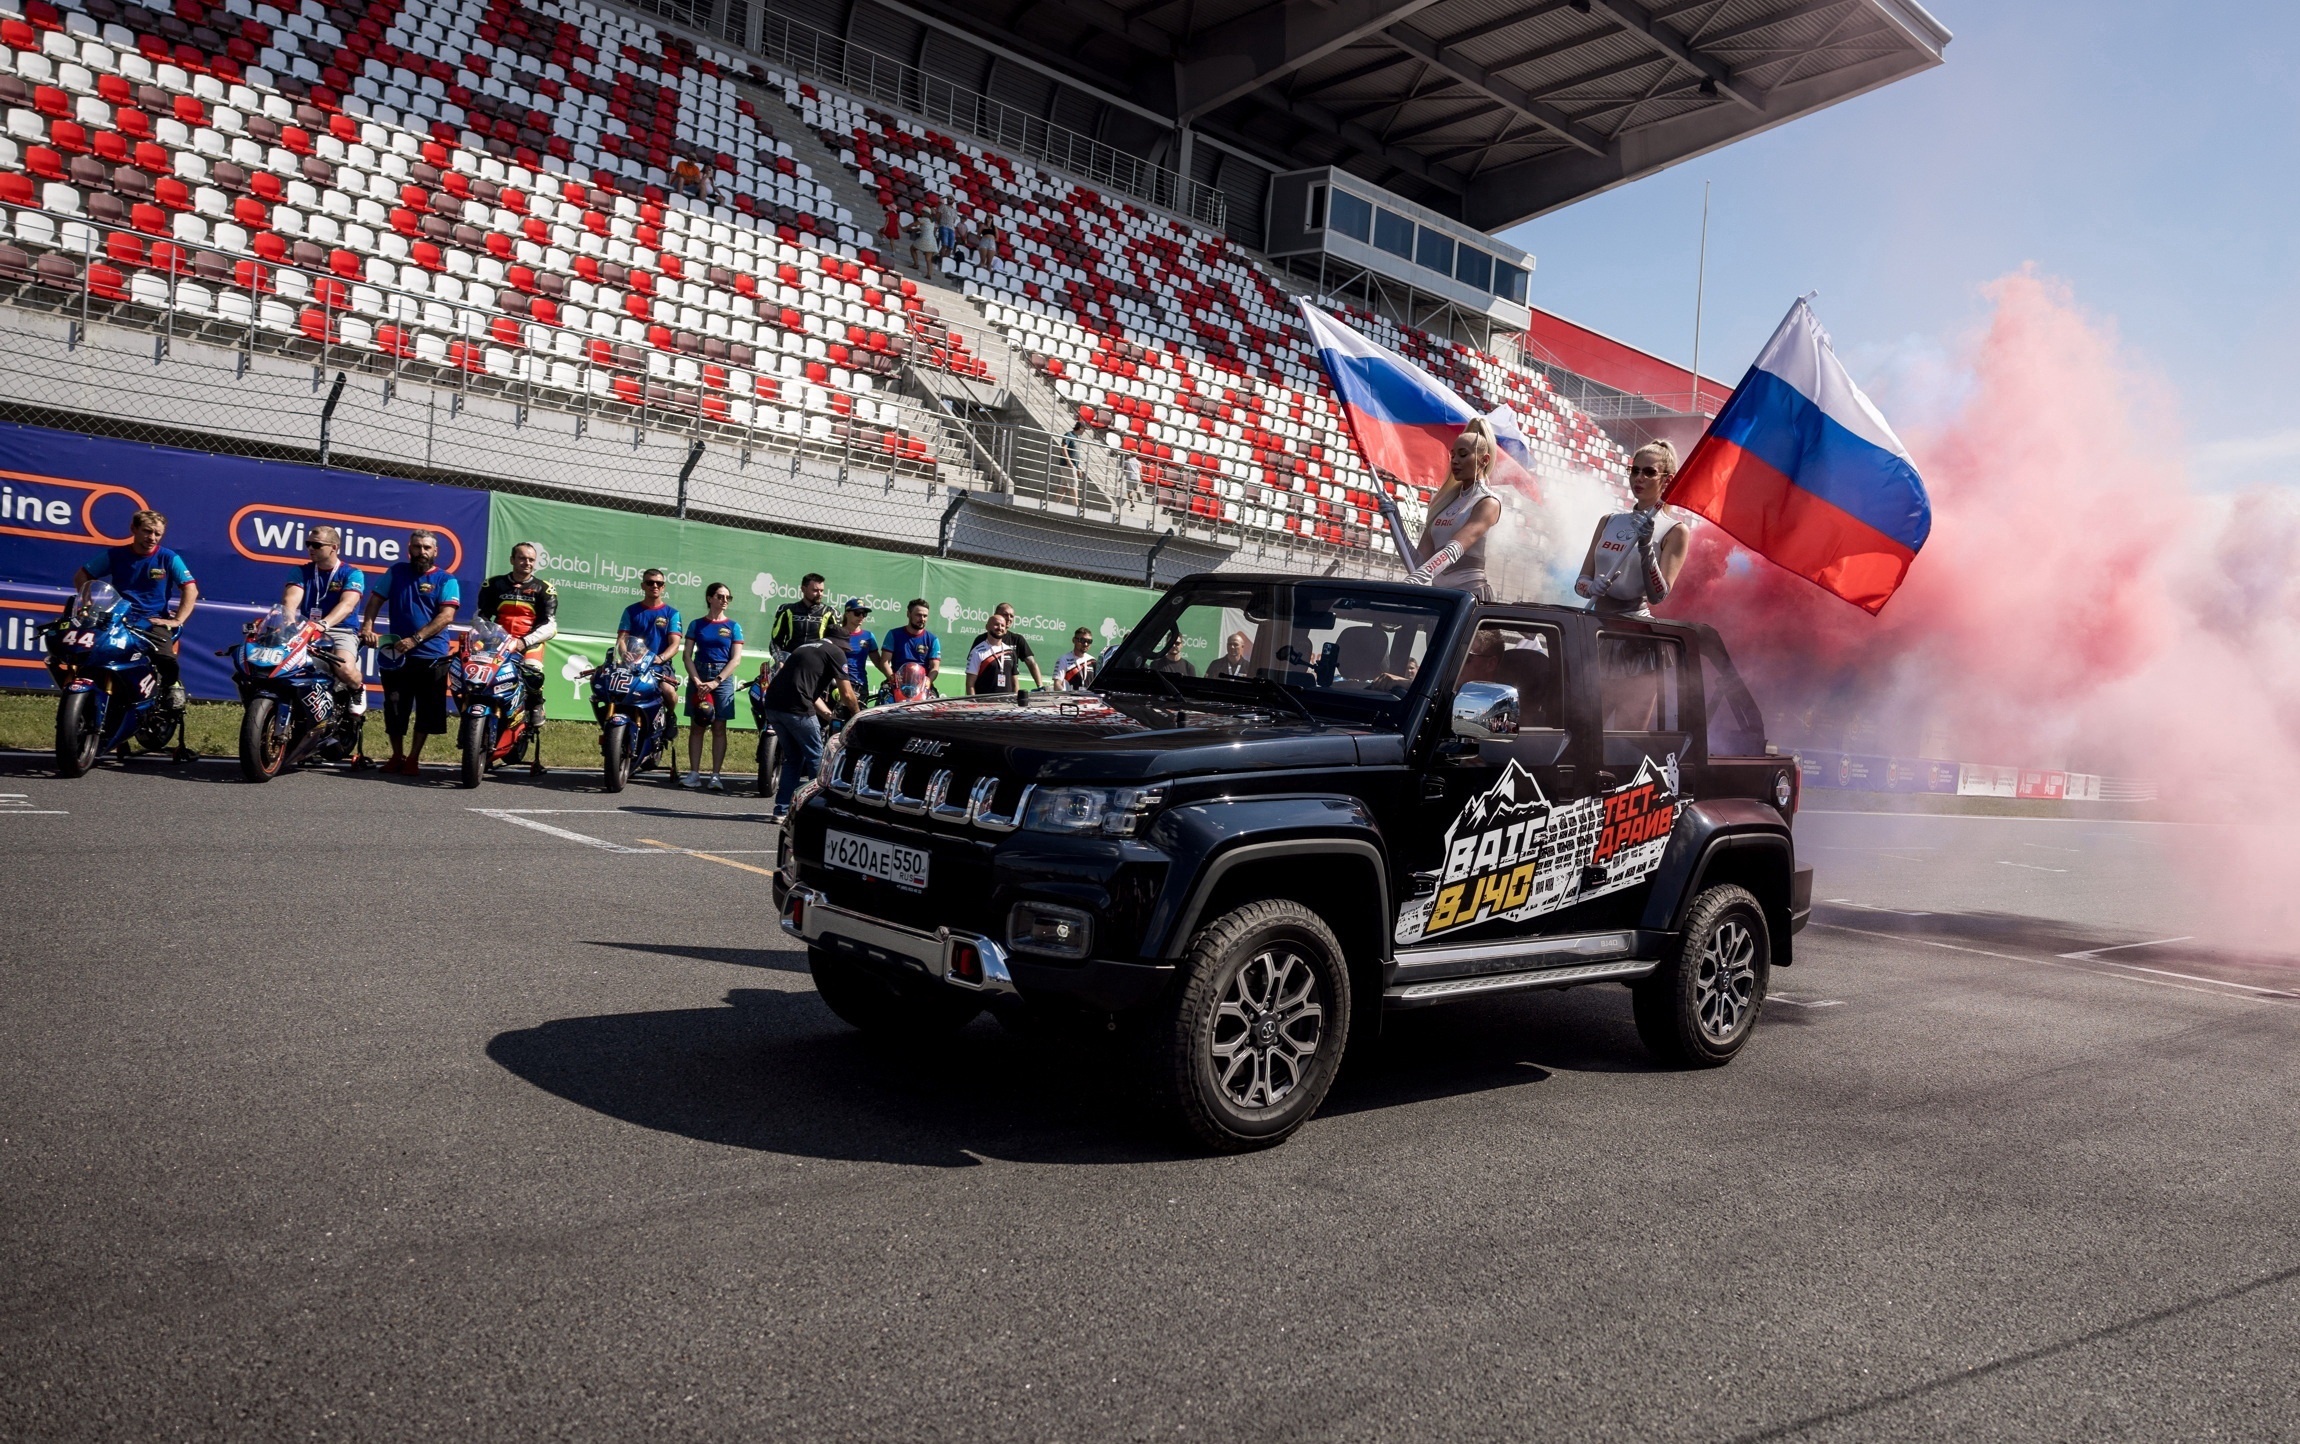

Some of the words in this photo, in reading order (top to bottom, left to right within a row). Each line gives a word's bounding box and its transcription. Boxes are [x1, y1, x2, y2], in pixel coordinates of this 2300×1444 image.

[253, 517, 400, 561] Wiine
[1602, 541, 1627, 552] BAI
[600, 559, 702, 588] HypeScale
[611, 585, 630, 595] ДЛЯ
[62, 629, 95, 648] 44
[246, 647, 285, 666] 246
[465, 663, 492, 683] 91
[609, 671, 633, 693] 12
[139, 673, 157, 698] 44
[302, 682, 334, 723] 246
[902, 737, 951, 758] BAIC
[1604, 784, 1660, 825] ТЕСТ-
[893, 849, 922, 874] 550
[1444, 816, 1547, 885] BAIC
[899, 872, 914, 883] RUS
[1424, 862, 1538, 932] BJ40
